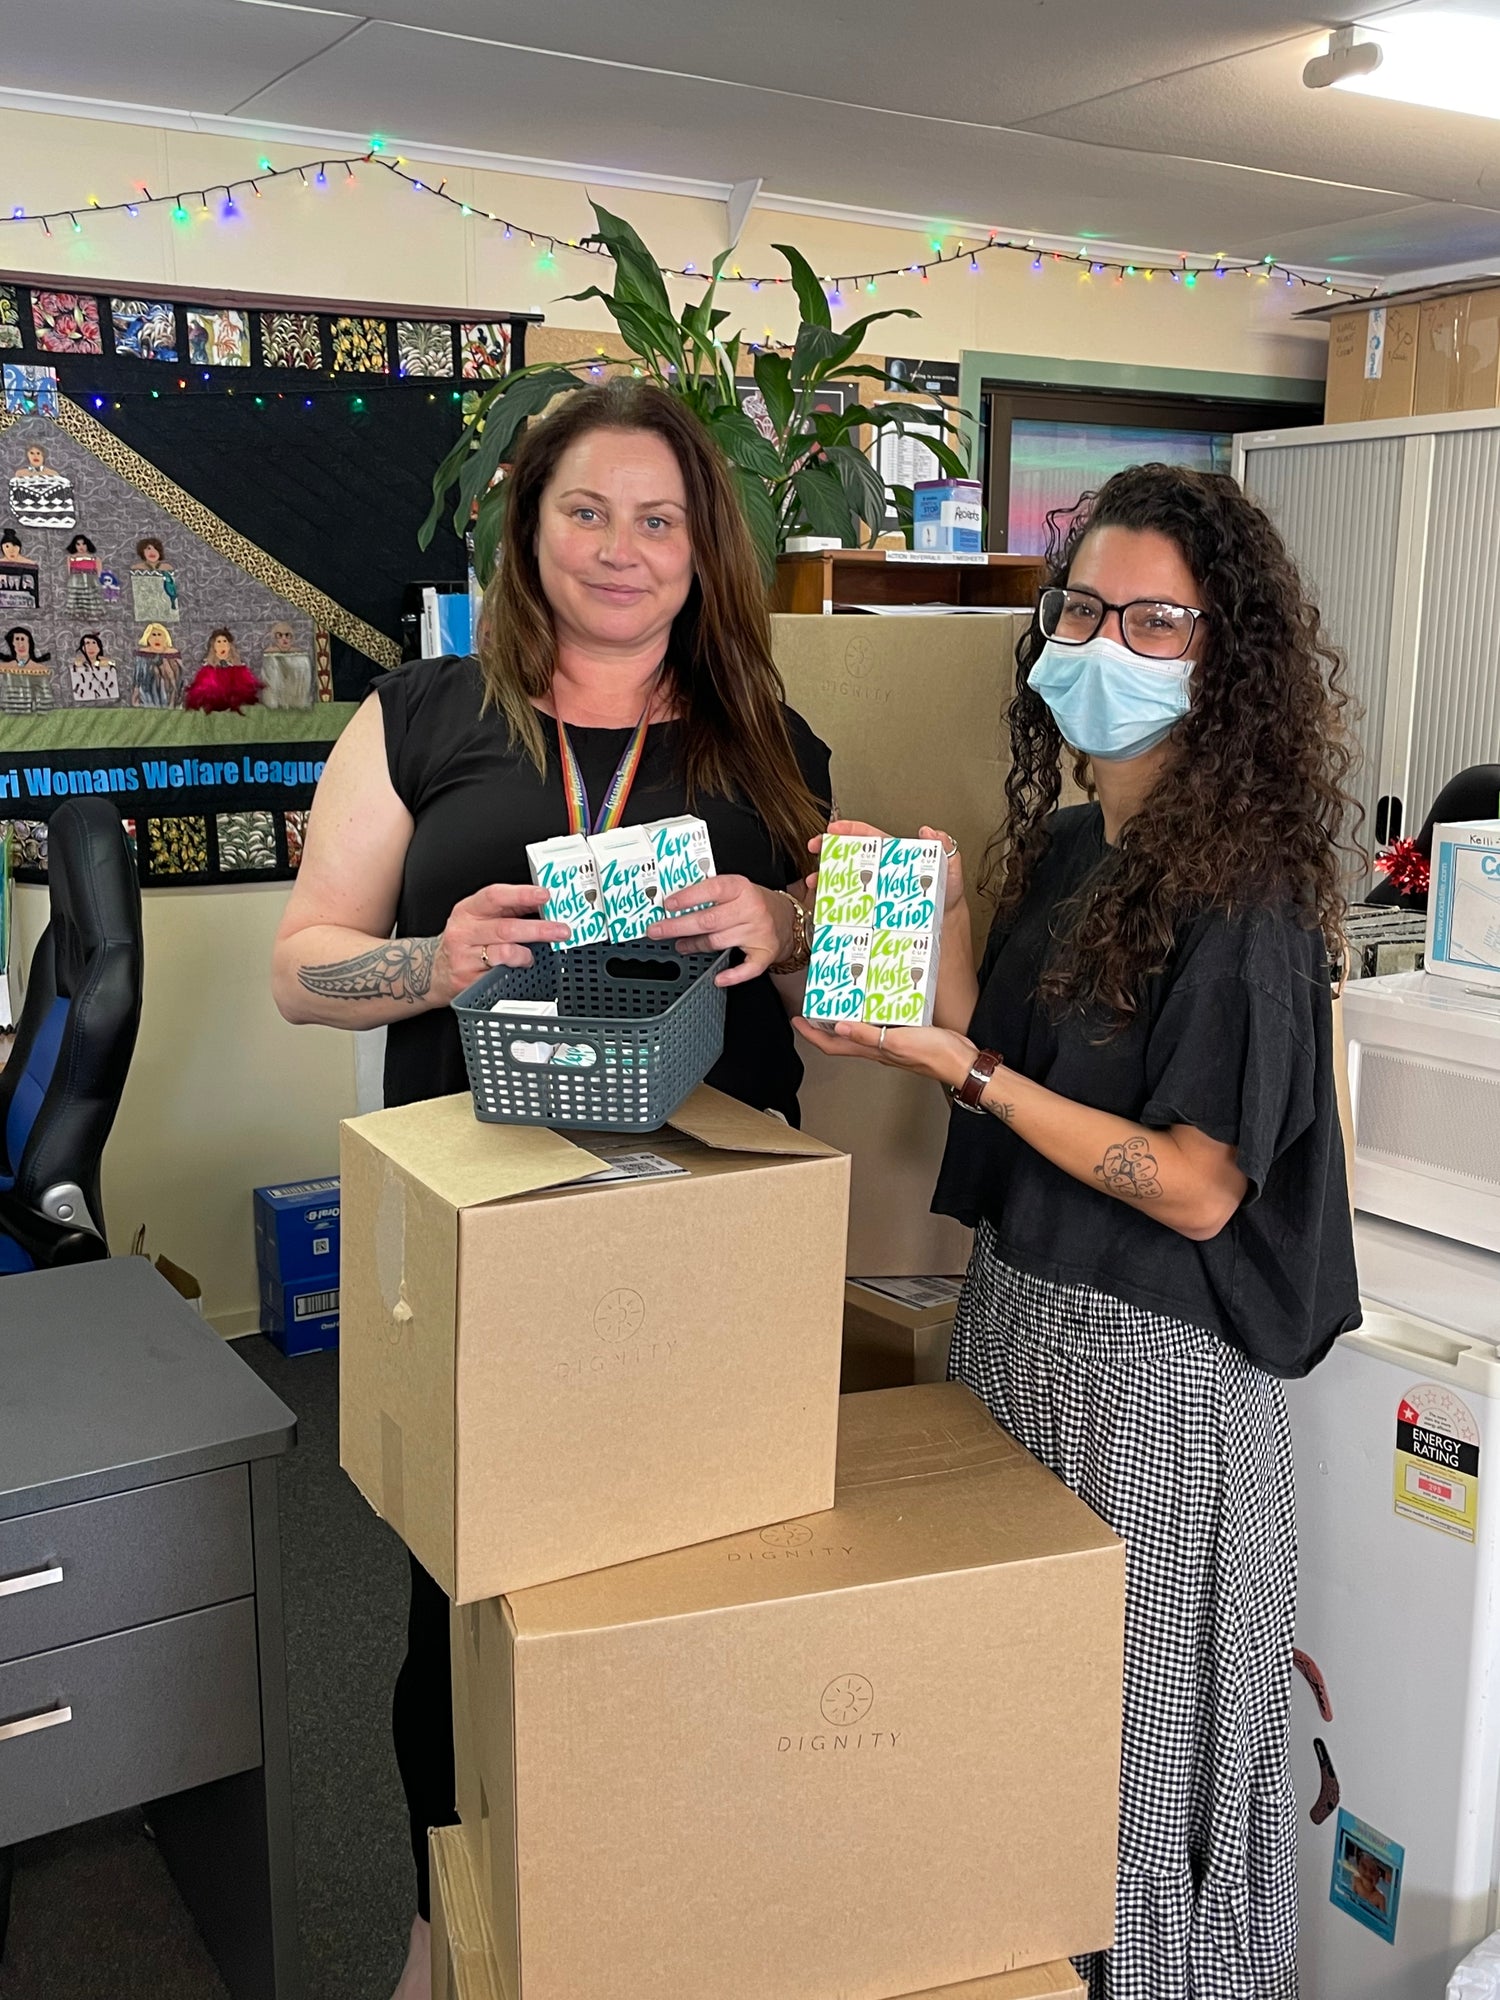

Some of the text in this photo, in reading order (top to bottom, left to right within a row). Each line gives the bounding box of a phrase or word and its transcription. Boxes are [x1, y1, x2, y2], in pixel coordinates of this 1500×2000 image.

[24, 767, 139, 796] Womans
[141, 758, 239, 789] Welfare
[243, 756, 326, 787] League
[651, 826, 691, 863] Zero
[821, 834, 862, 864] Zero
[879, 838, 922, 868] Zero
[536, 861, 578, 891] Zero
[600, 859, 640, 893] Zero
[659, 851, 700, 895] Waste
[818, 858, 861, 894] Waste
[877, 864, 920, 900] Waste
[543, 883, 586, 921] Waste
[603, 880, 646, 919] Waste
[812, 925, 853, 955] Zero
[871, 930, 913, 959] Zero
[808, 951, 851, 988] Waste
[867, 955, 911, 991] Waste
[556, 1339, 678, 1378] DIGNITY
[1412, 1428, 1462, 1454] ENERGY
[1413, 1441, 1460, 1468] RATING
[727, 1546, 854, 1562] DIGNITY
[777, 1732, 903, 1753] DIGNITY
